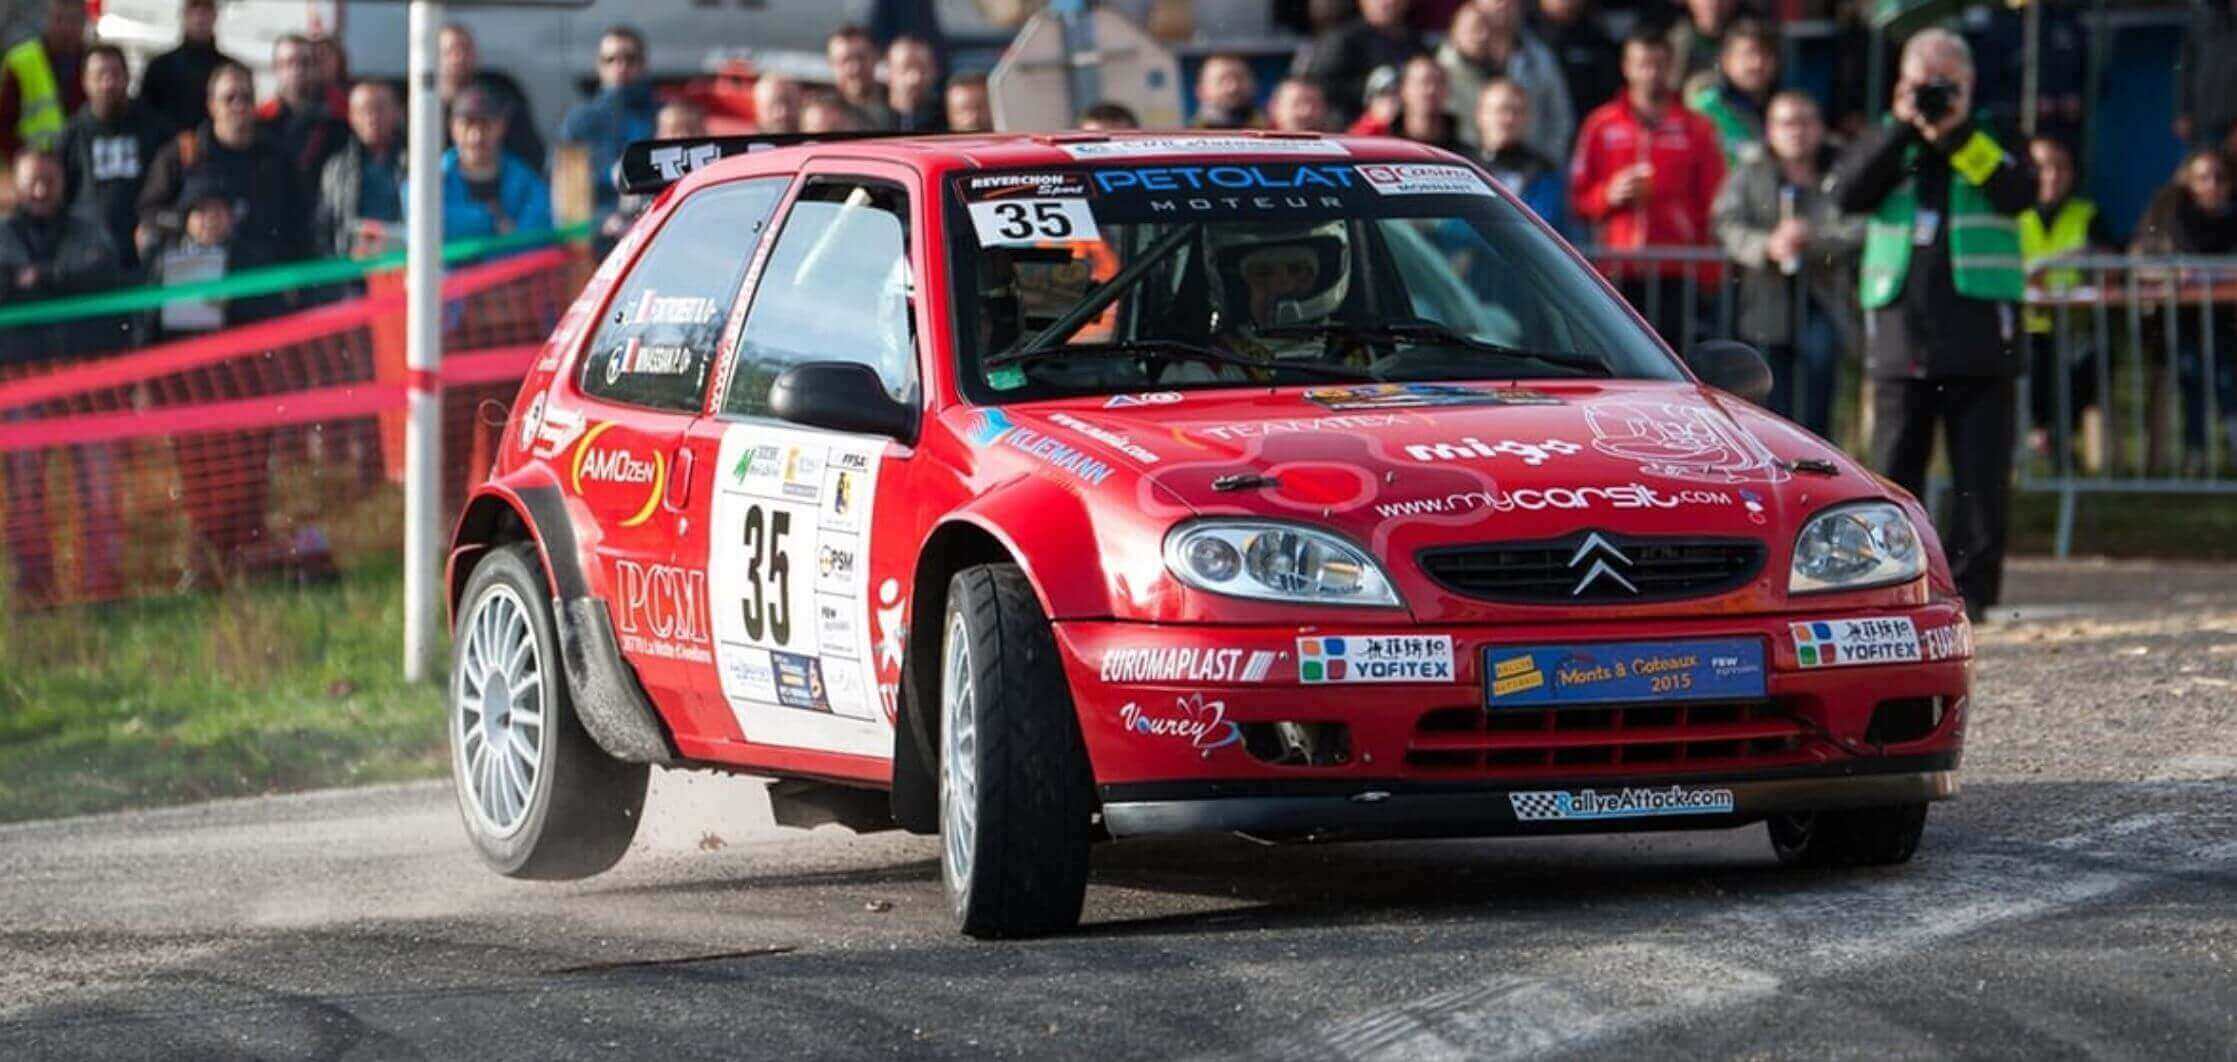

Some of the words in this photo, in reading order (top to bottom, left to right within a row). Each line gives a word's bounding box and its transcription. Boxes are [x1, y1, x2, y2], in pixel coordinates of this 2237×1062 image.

[971, 174, 1064, 189] REVERCHON
[1094, 165, 1354, 193] PETOLAT
[1395, 167, 1472, 181] Casino
[1150, 196, 1344, 212] MOTEUR
[993, 202, 1073, 239] 35
[1202, 412, 1409, 440] TEAMTEX
[1404, 437, 1584, 466] migo
[742, 504, 791, 646] 35
[616, 560, 710, 644] PCM
[1101, 648, 1243, 682] EUROMAPLAST
[1842, 642, 1918, 660] YOFITEX
[1355, 662, 1449, 677] YOFITEX
[1557, 665, 1611, 686] Monts
[1632, 655, 1699, 675] Coteaux
[1650, 673, 1693, 693] 2015
[1120, 702, 1209, 745] Vourey
[1557, 785, 1733, 813] RallyeAttack.com
